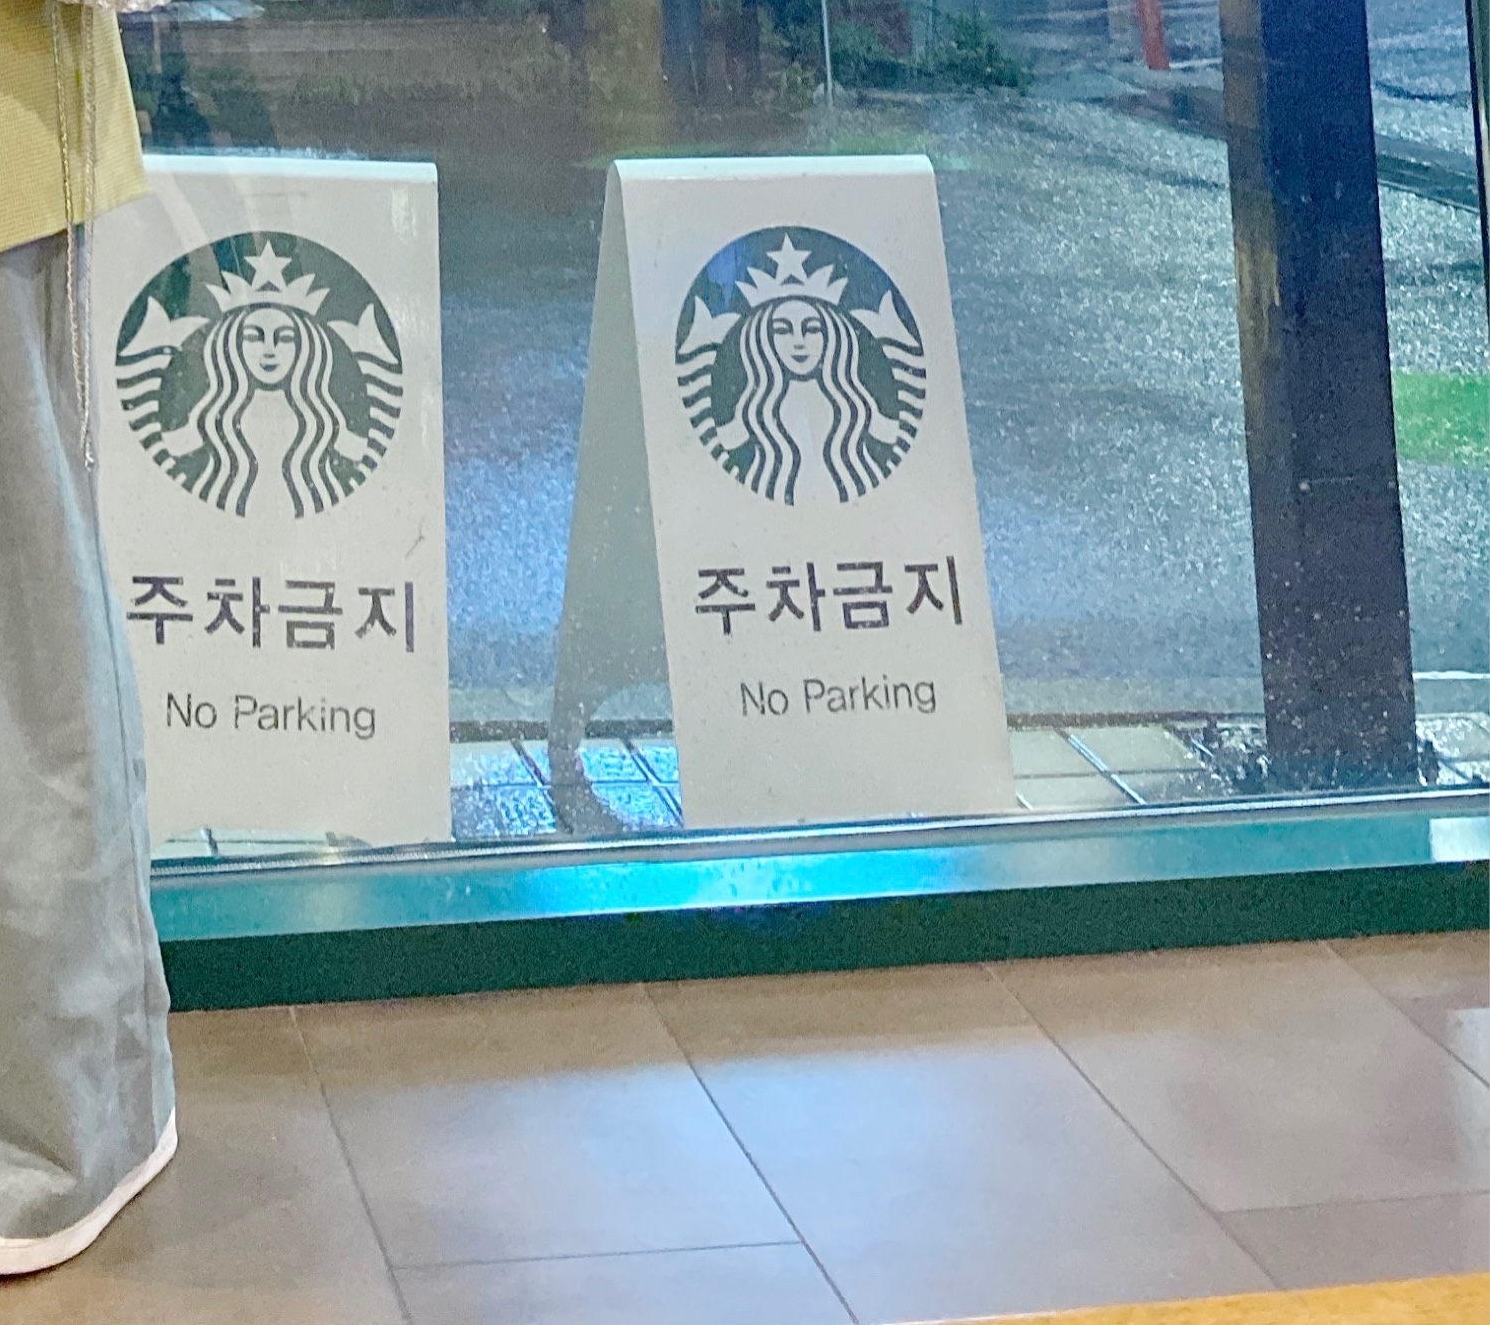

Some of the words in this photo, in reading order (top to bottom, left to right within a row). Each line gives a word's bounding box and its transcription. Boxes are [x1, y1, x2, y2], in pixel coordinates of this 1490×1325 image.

[126, 576, 415, 653] 주차금지
[695, 555, 963, 635] 주차금지
[166, 692, 218, 729] No
[233, 694, 376, 740] Parking
[740, 681, 789, 717] No
[803, 674, 937, 716] Parking
